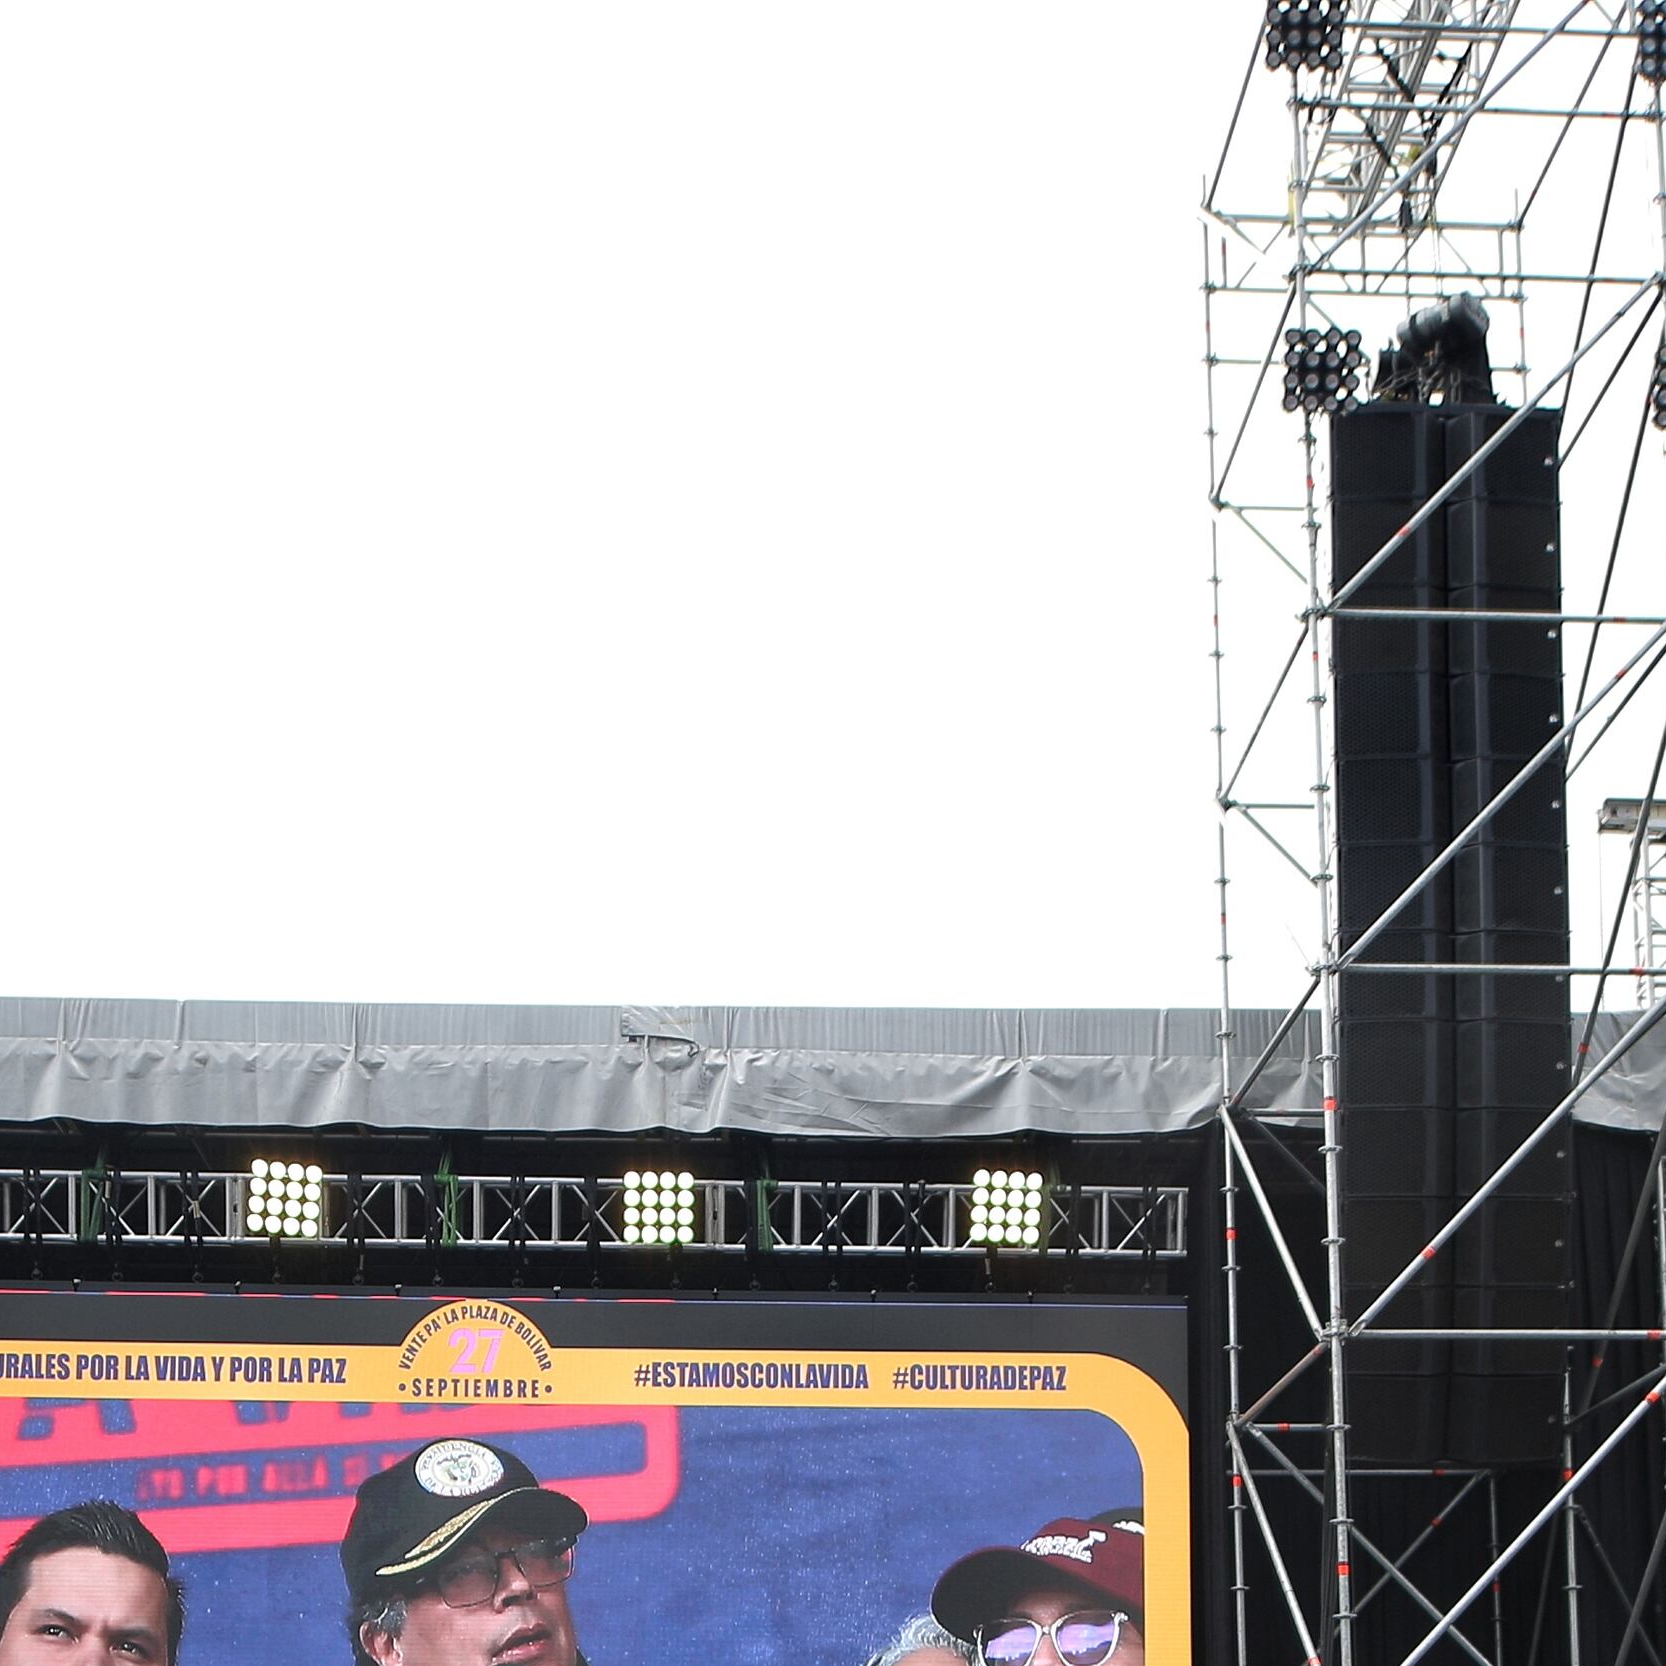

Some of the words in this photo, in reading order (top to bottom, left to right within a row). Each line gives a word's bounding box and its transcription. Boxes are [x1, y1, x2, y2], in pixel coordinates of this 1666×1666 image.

[398, 1331, 427, 1370] VENTE
[424, 1317, 442, 1337] PA'
[443, 1308, 459, 1325] LA
[461, 1304, 498, 1322] PLAZA
[499, 1311, 517, 1329] DE
[514, 1321, 552, 1372] BOLÍVAR
[449, 1327, 504, 1374] 27
[76, 1354, 119, 1380] POR
[125, 1355, 149, 1381] LA
[155, 1355, 206, 1381] VIDA
[211, 1356, 225, 1382] Y
[229, 1356, 272, 1383] POR
[278, 1357, 303, 1383] LA
[308, 1357, 347, 1384] PAZ
[634, 1361, 869, 1389] #ESTAMOSCONLAVIDA
[892, 1364, 1067, 1391] #CULTURADEPAZ
[411, 1378, 539, 1398] SEPTIEMBRE
